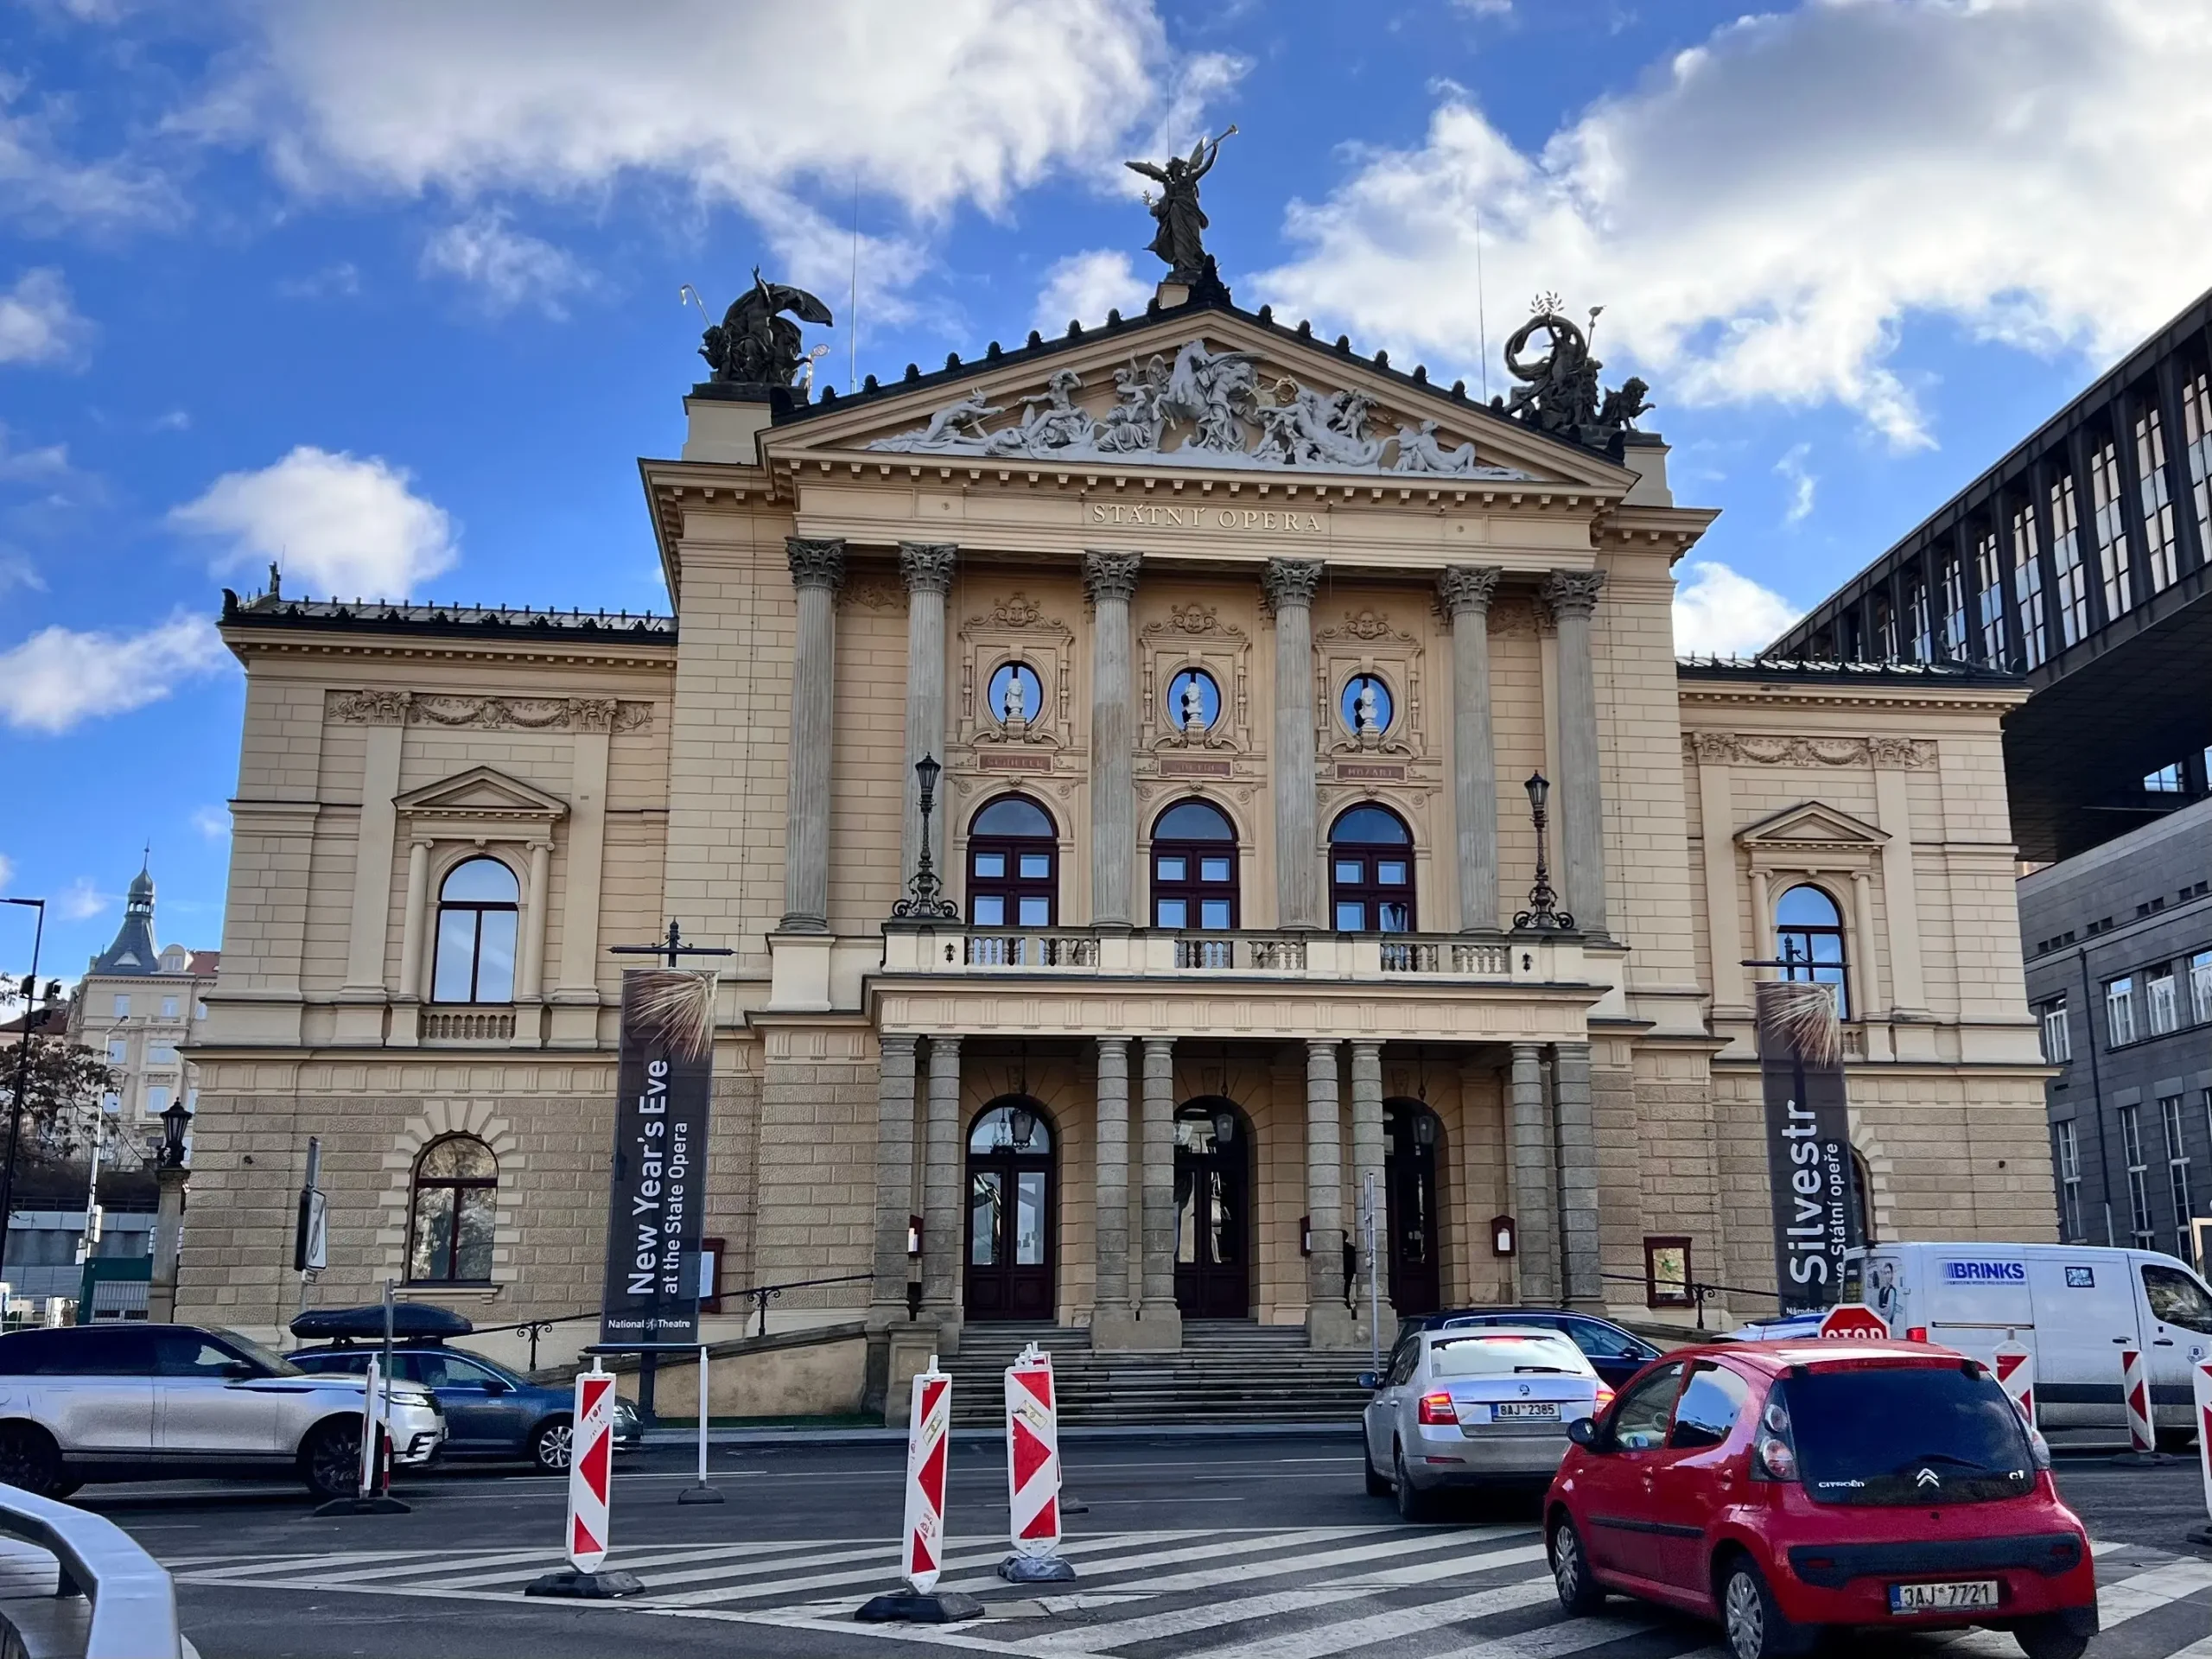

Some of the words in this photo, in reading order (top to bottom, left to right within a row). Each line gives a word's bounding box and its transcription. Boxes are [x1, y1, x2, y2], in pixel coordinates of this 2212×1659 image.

[1092, 504, 1206, 527] STÁTNÍ
[1217, 511, 1322, 531] OPERA
[639, 1060, 668, 1114] Eve
[632, 1122, 664, 1216] Year's
[668, 1122, 689, 1179] Opera
[1823, 1143, 1845, 1197] opeře
[664, 1184, 683, 1234] State
[1781, 1099, 1828, 1285] Silvestr
[1827, 1200, 1847, 1256] Státní
[626, 1224, 658, 1294] New
[662, 1239, 680, 1270] the
[1954, 1262, 2024, 1280] BRINKS
[662, 1275, 678, 1294] at
[608, 1319, 645, 1329] National
[658, 1319, 690, 1329] Theatre
[1500, 1404, 1521, 1416] 8AJ
[1528, 1404, 1555, 1415] 2385
[1904, 1586, 1935, 1606] 3AJ
[1948, 1584, 1989, 1605] 7721
